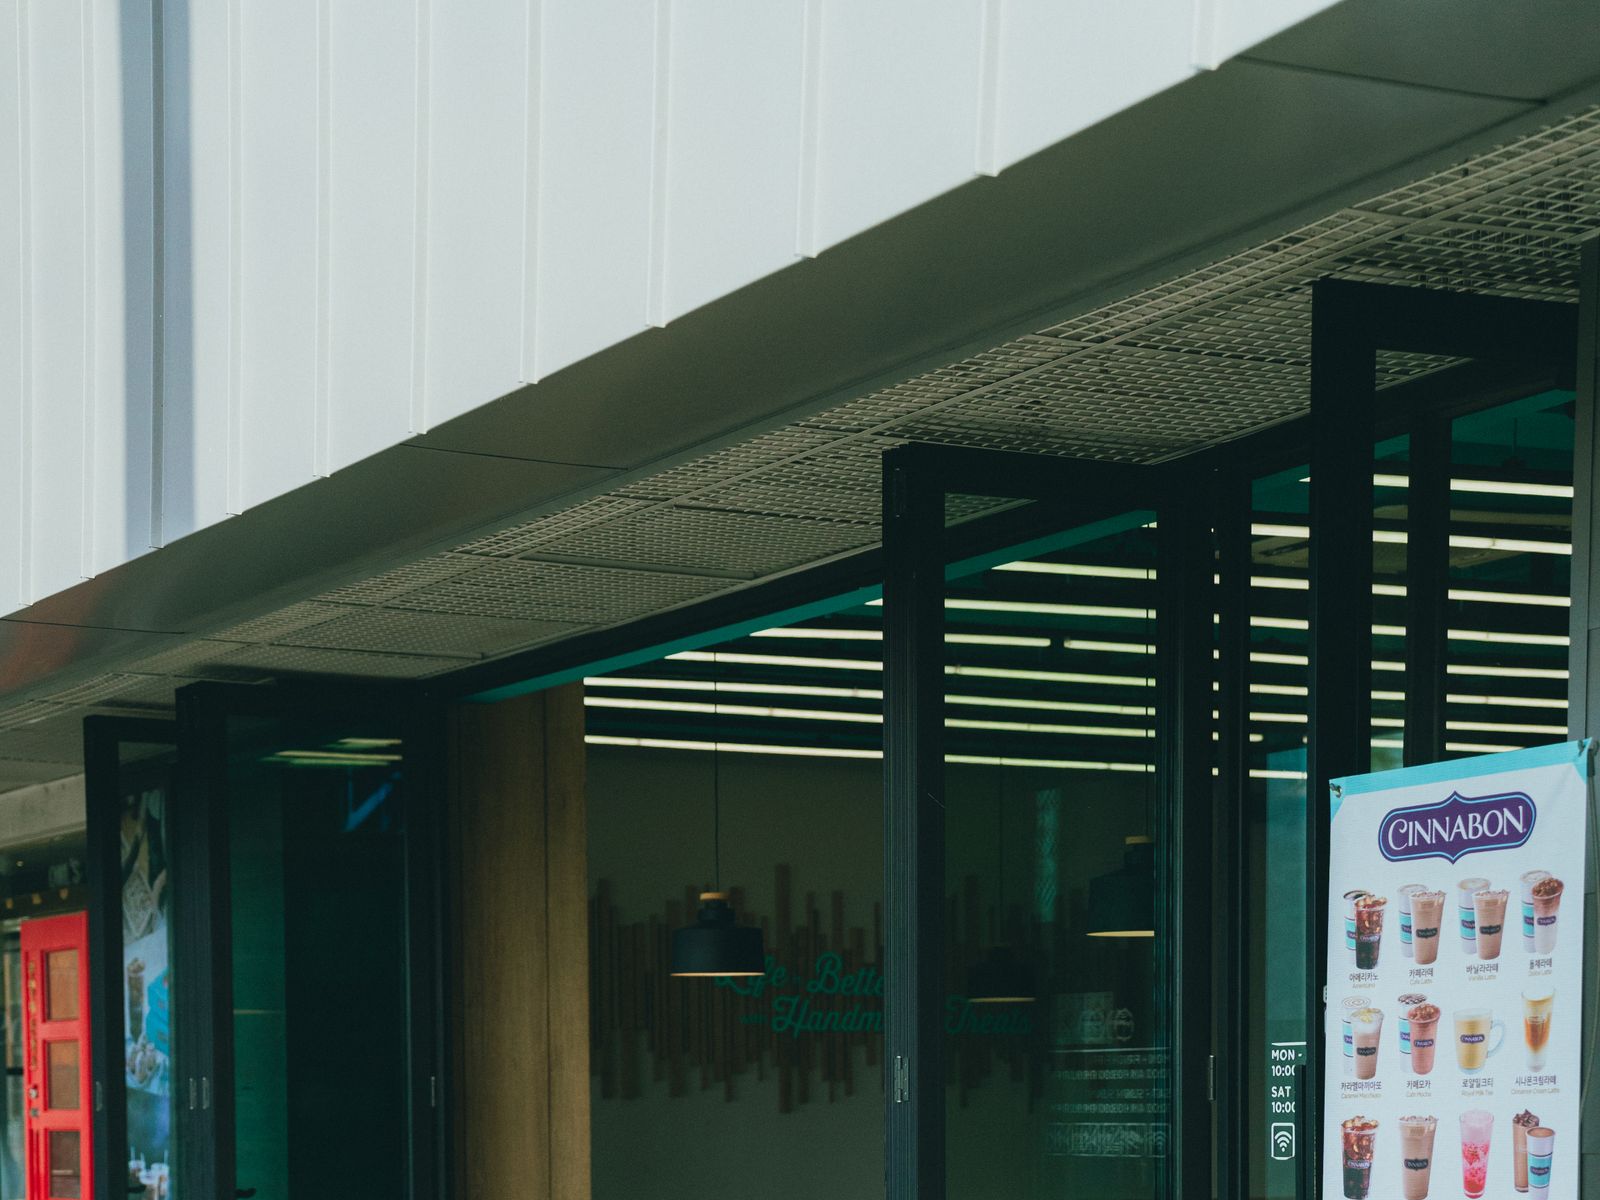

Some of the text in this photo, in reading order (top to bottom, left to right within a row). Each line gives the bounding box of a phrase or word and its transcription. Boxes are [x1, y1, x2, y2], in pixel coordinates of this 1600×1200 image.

[1388, 805, 1524, 850] CINNABON
[806, 950, 884, 996] Bette
[771, 995, 884, 1039] Handm
[1271, 1049, 1295, 1061] MON
[1271, 1085, 1291, 1098] SAT
